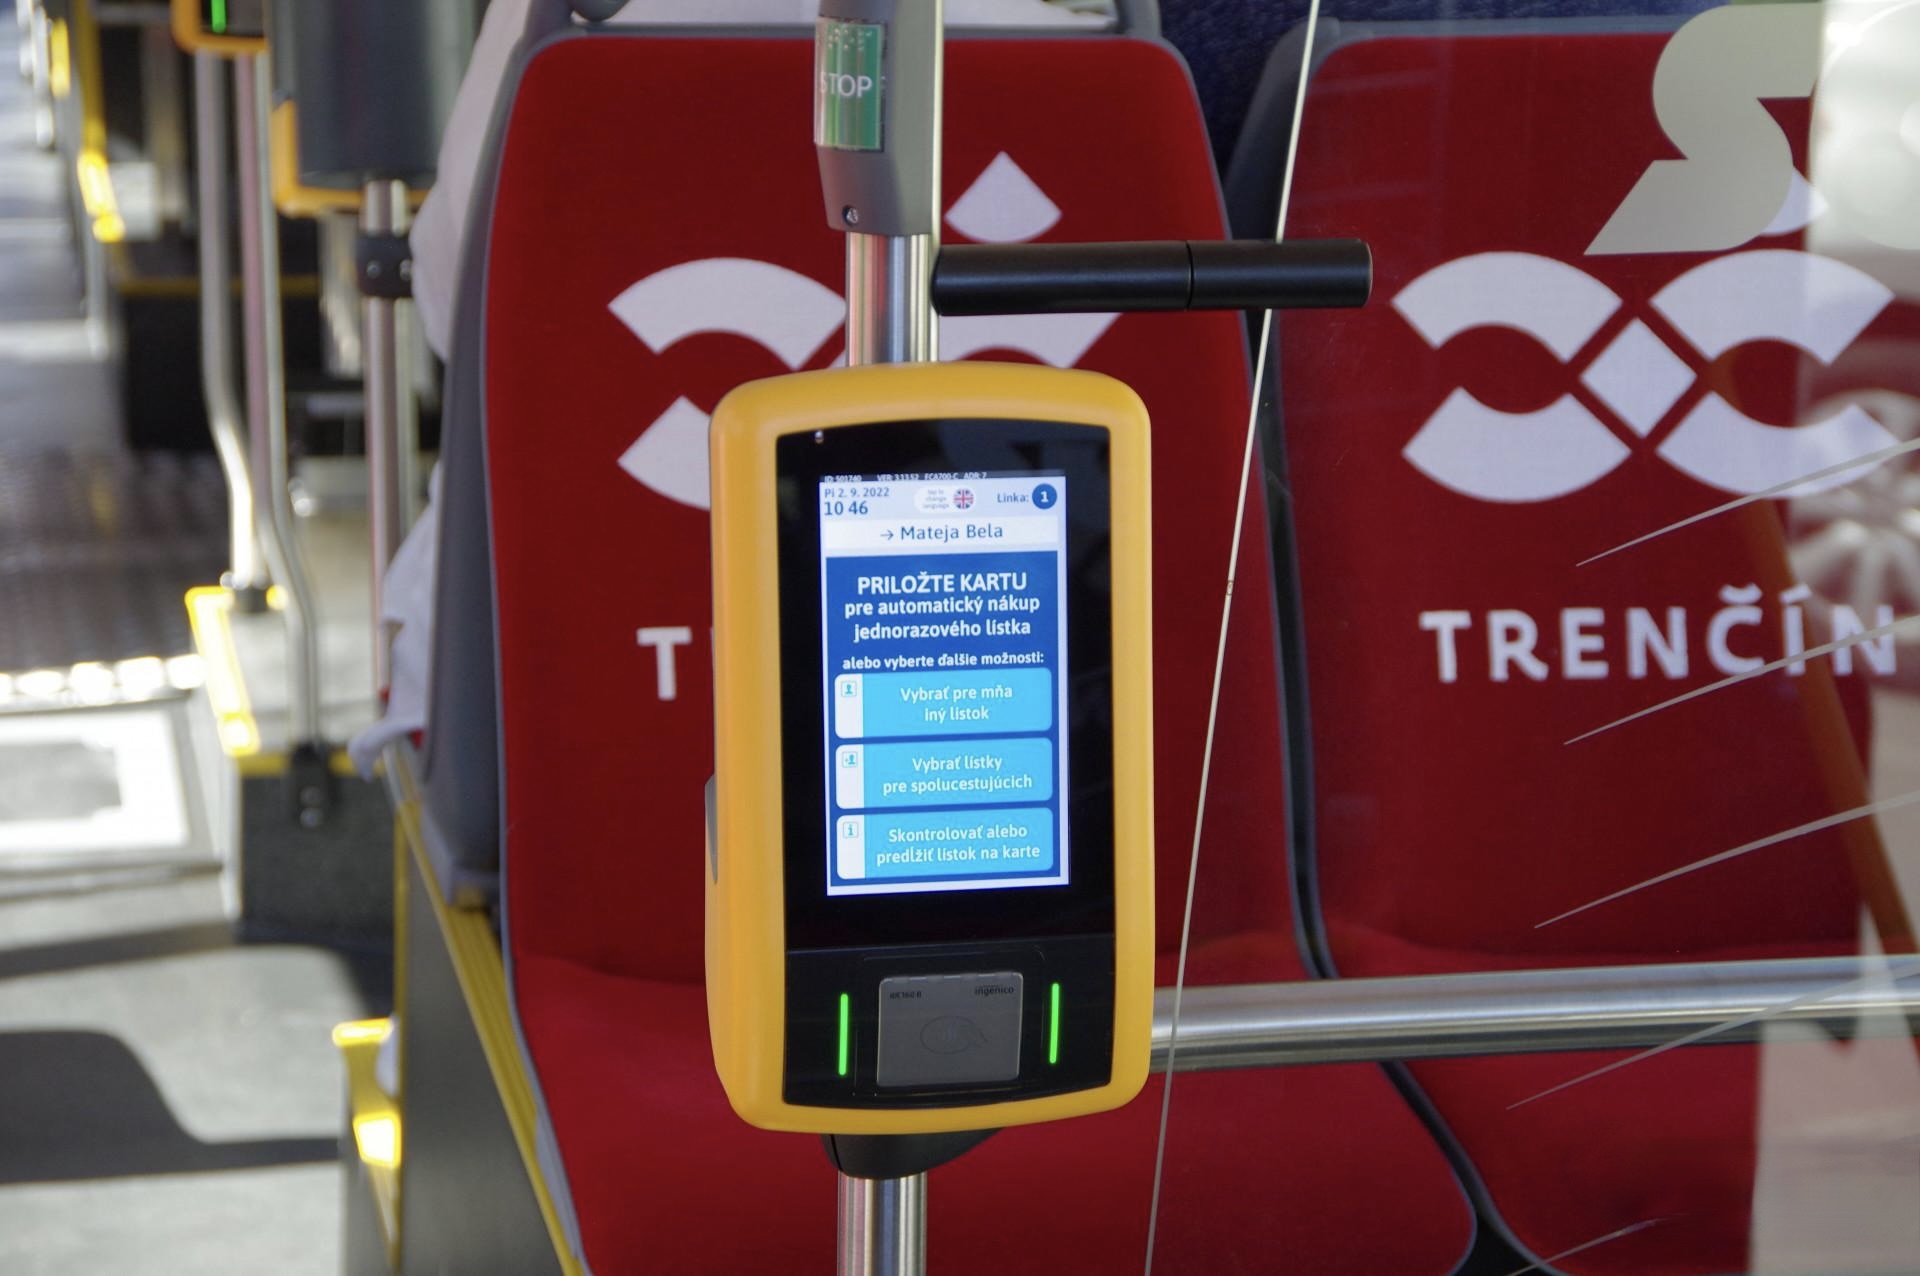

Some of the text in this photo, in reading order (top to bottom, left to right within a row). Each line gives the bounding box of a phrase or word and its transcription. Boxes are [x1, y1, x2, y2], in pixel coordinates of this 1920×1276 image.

[819, 71, 873, 98] STOP
[863, 486, 890, 497] 2022
[996, 490, 1049, 504] Linka: 1
[900, 522, 1004, 543] Mateja Bela
[857, 571, 1028, 595] PRILOŽTE KARTU
[844, 594, 1041, 619] pre automatický nákup
[853, 618, 1031, 643] jednorazového lístka
[1418, 583, 1898, 684] TRENČÍN
[842, 650, 1045, 671] alebo vyberte ďalšie možnosti:
[900, 685, 1013, 705] Vybrať pre mňa
[924, 705, 989, 723] iný lístok
[912, 754, 1003, 774] Vybrať lístky
[882, 774, 1033, 797] pre spolucestujúcich
[888, 823, 1028, 843] Skontrolovať alebo
[937, 846, 977, 862] lístok
[980, 847, 999, 860] na
[1002, 844, 1041, 859] karte
